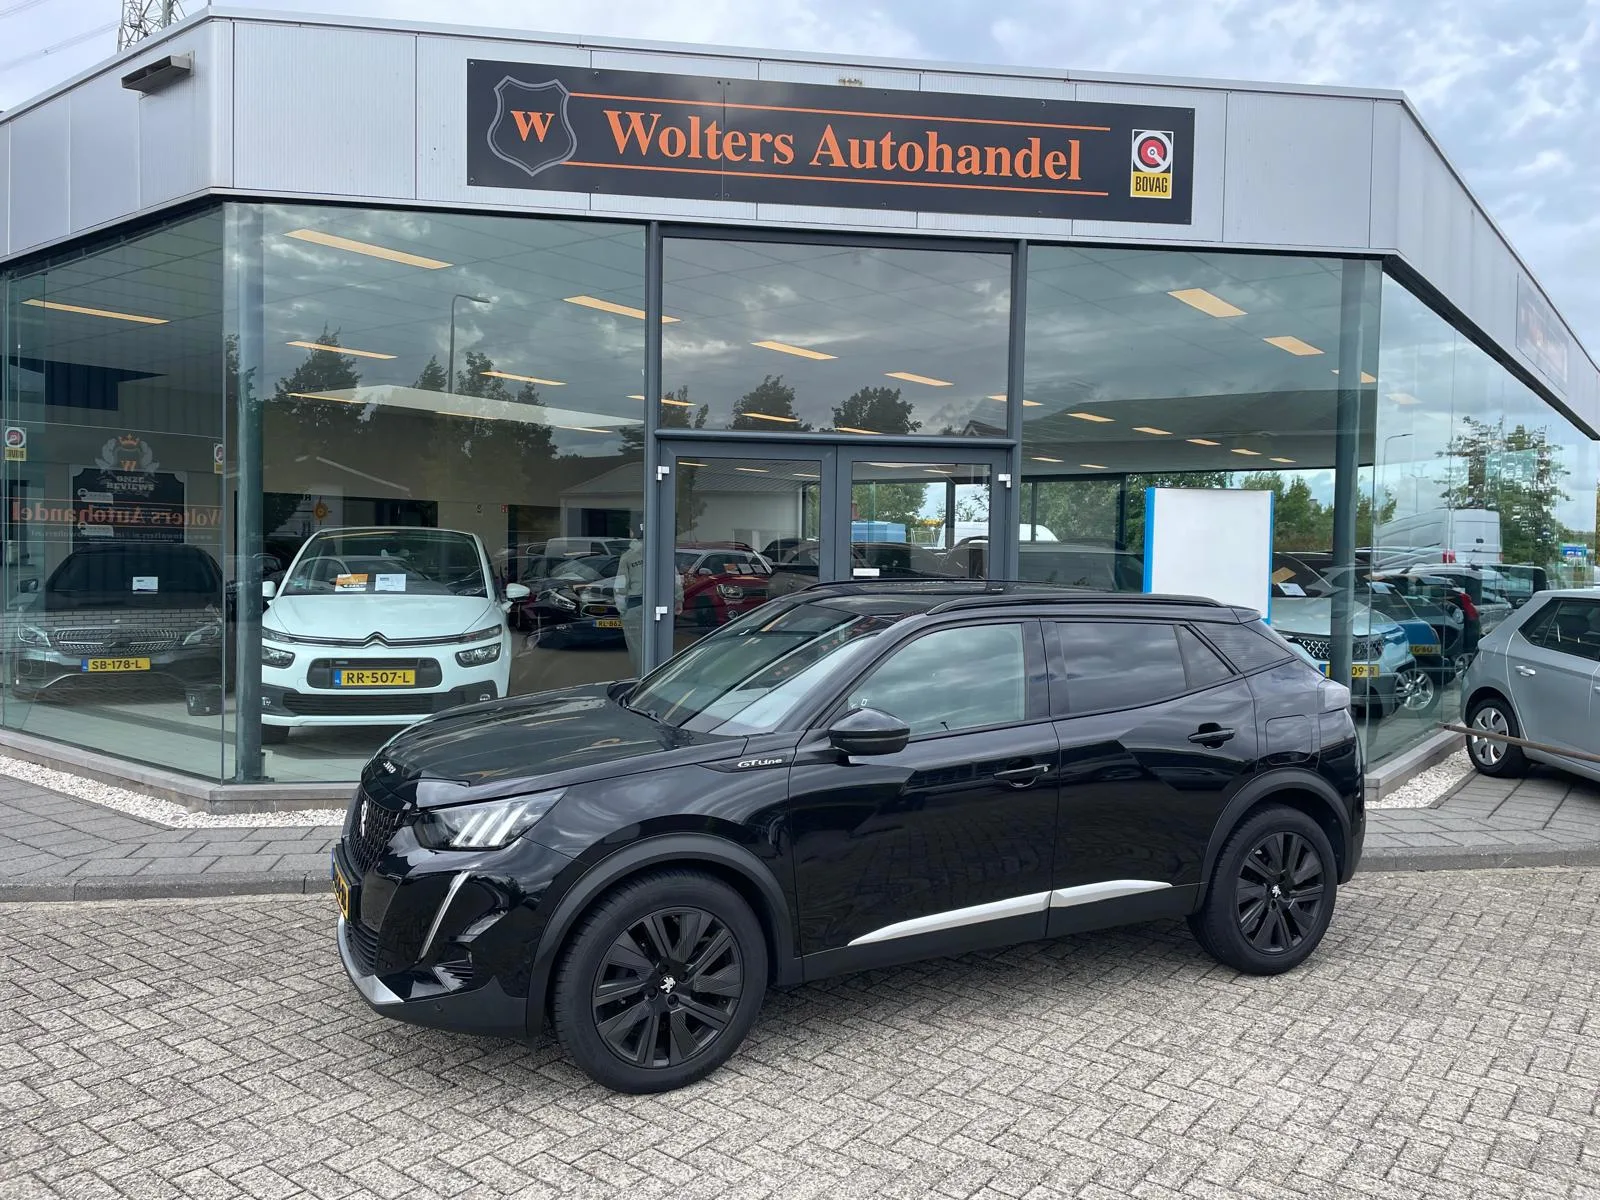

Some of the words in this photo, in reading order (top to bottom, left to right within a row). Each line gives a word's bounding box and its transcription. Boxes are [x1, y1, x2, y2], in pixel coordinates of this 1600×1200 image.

[510, 110, 555, 143] W
[603, 110, 795, 165] Wolters
[808, 123, 1083, 182] Autohandel
[1134, 174, 1168, 194] BOVAG
[91, 659, 142, 670] SB-178-L
[346, 671, 410, 684] RR-507-L
[737, 759, 758, 768] GT
